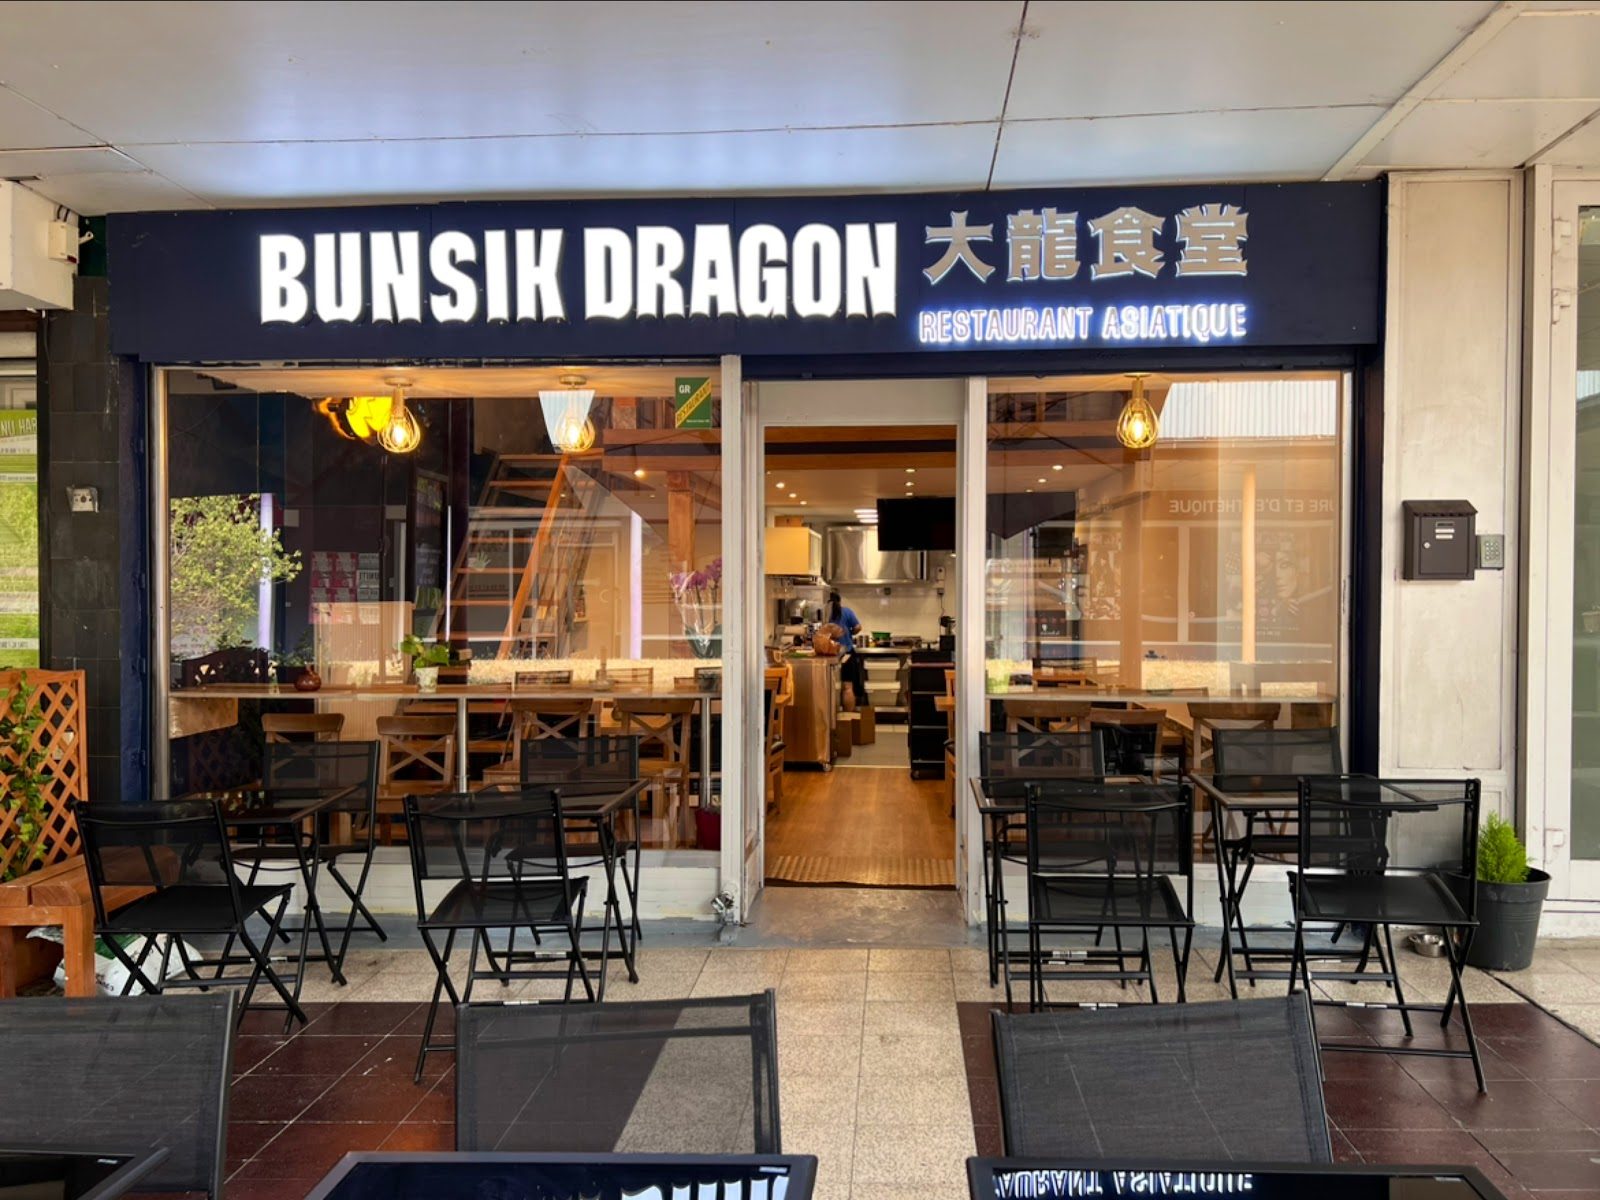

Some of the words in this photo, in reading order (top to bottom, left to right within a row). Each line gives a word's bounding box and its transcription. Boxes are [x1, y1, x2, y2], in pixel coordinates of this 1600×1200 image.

[260, 229, 566, 325] BUNSIK
[584, 222, 897, 321] DRAGON
[922, 203, 1250, 285] 大龍食堂
[918, 306, 1093, 344] RESTAURANT
[1101, 302, 1248, 343] ASIATIQUE
[679, 384, 691, 394] GR
